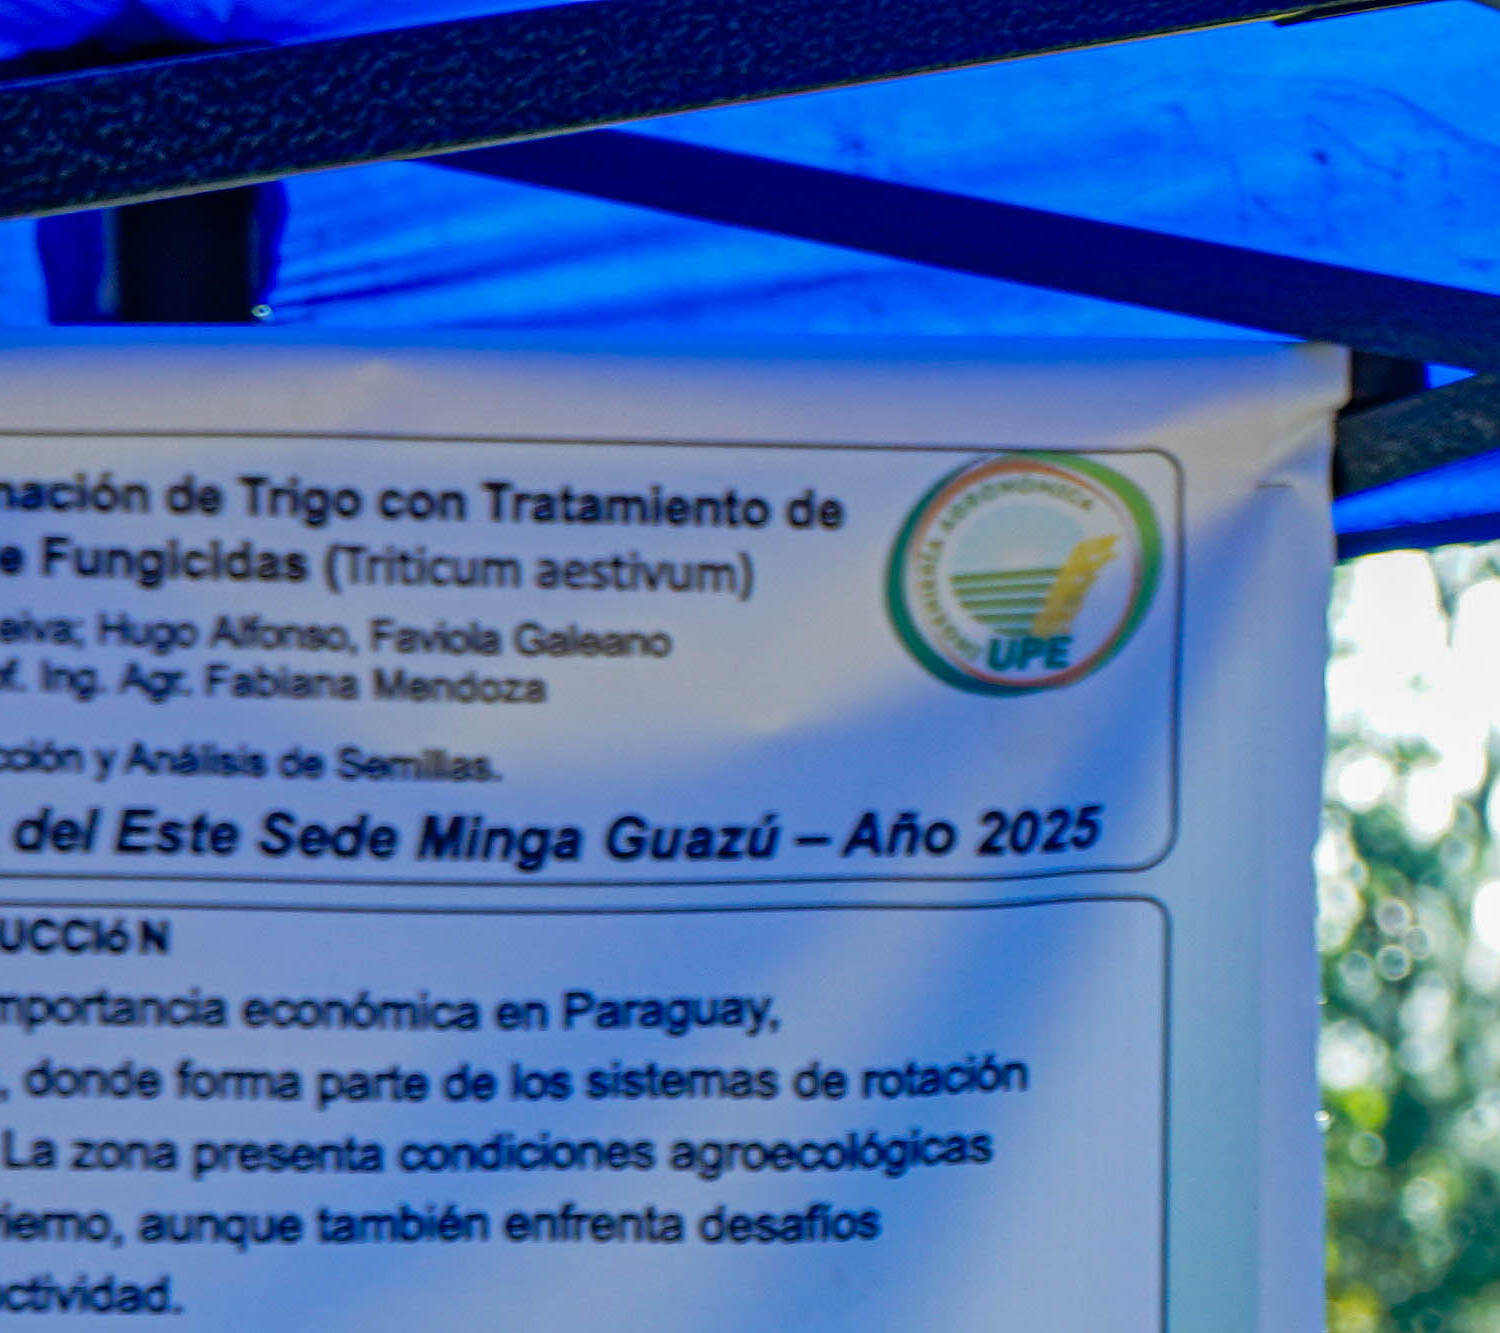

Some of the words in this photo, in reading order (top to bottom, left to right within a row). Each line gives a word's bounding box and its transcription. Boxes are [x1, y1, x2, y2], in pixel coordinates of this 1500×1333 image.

[166, 475, 224, 517] de
[238, 474, 363, 529] Trigo
[378, 488, 467, 522] con
[482, 480, 771, 529] Tratamiento
[786, 489, 845, 531] de
[42, 535, 309, 590] Fungicidas
[324, 543, 521, 594] (Triticum
[536, 552, 753, 601] aestivum)
[98, 613, 199, 656] Hugo
[210, 615, 357, 655] Alfonso,
[371, 618, 501, 657] Faviola
[987, 637, 1072, 670] UPE
[41, 660, 105, 703] Ing.
[206, 662, 359, 701] Fabiana
[373, 668, 546, 704] Mendoza
[95, 749, 116, 782] y
[124, 741, 268, 779] Análisis
[278, 747, 325, 780] de
[337, 745, 501, 783] Semillas.
[13, 806, 102, 854] del
[114, 807, 240, 857] Este
[258, 810, 399, 861] Sede
[417, 814, 583, 872] Minga
[605, 811, 781, 863] Guazú
[841, 810, 957, 858] Año
[977, 803, 1103, 857] 2025
[139, 919, 169, 955] N
[242, 990, 481, 1032] económica
[494, 1000, 549, 1031] en
[563, 989, 779, 1038] Paraguay,
[138, 1212, 304, 1253] aunque
[316, 1203, 489, 1244] también
[503, 1201, 684, 1244] enfrenta
